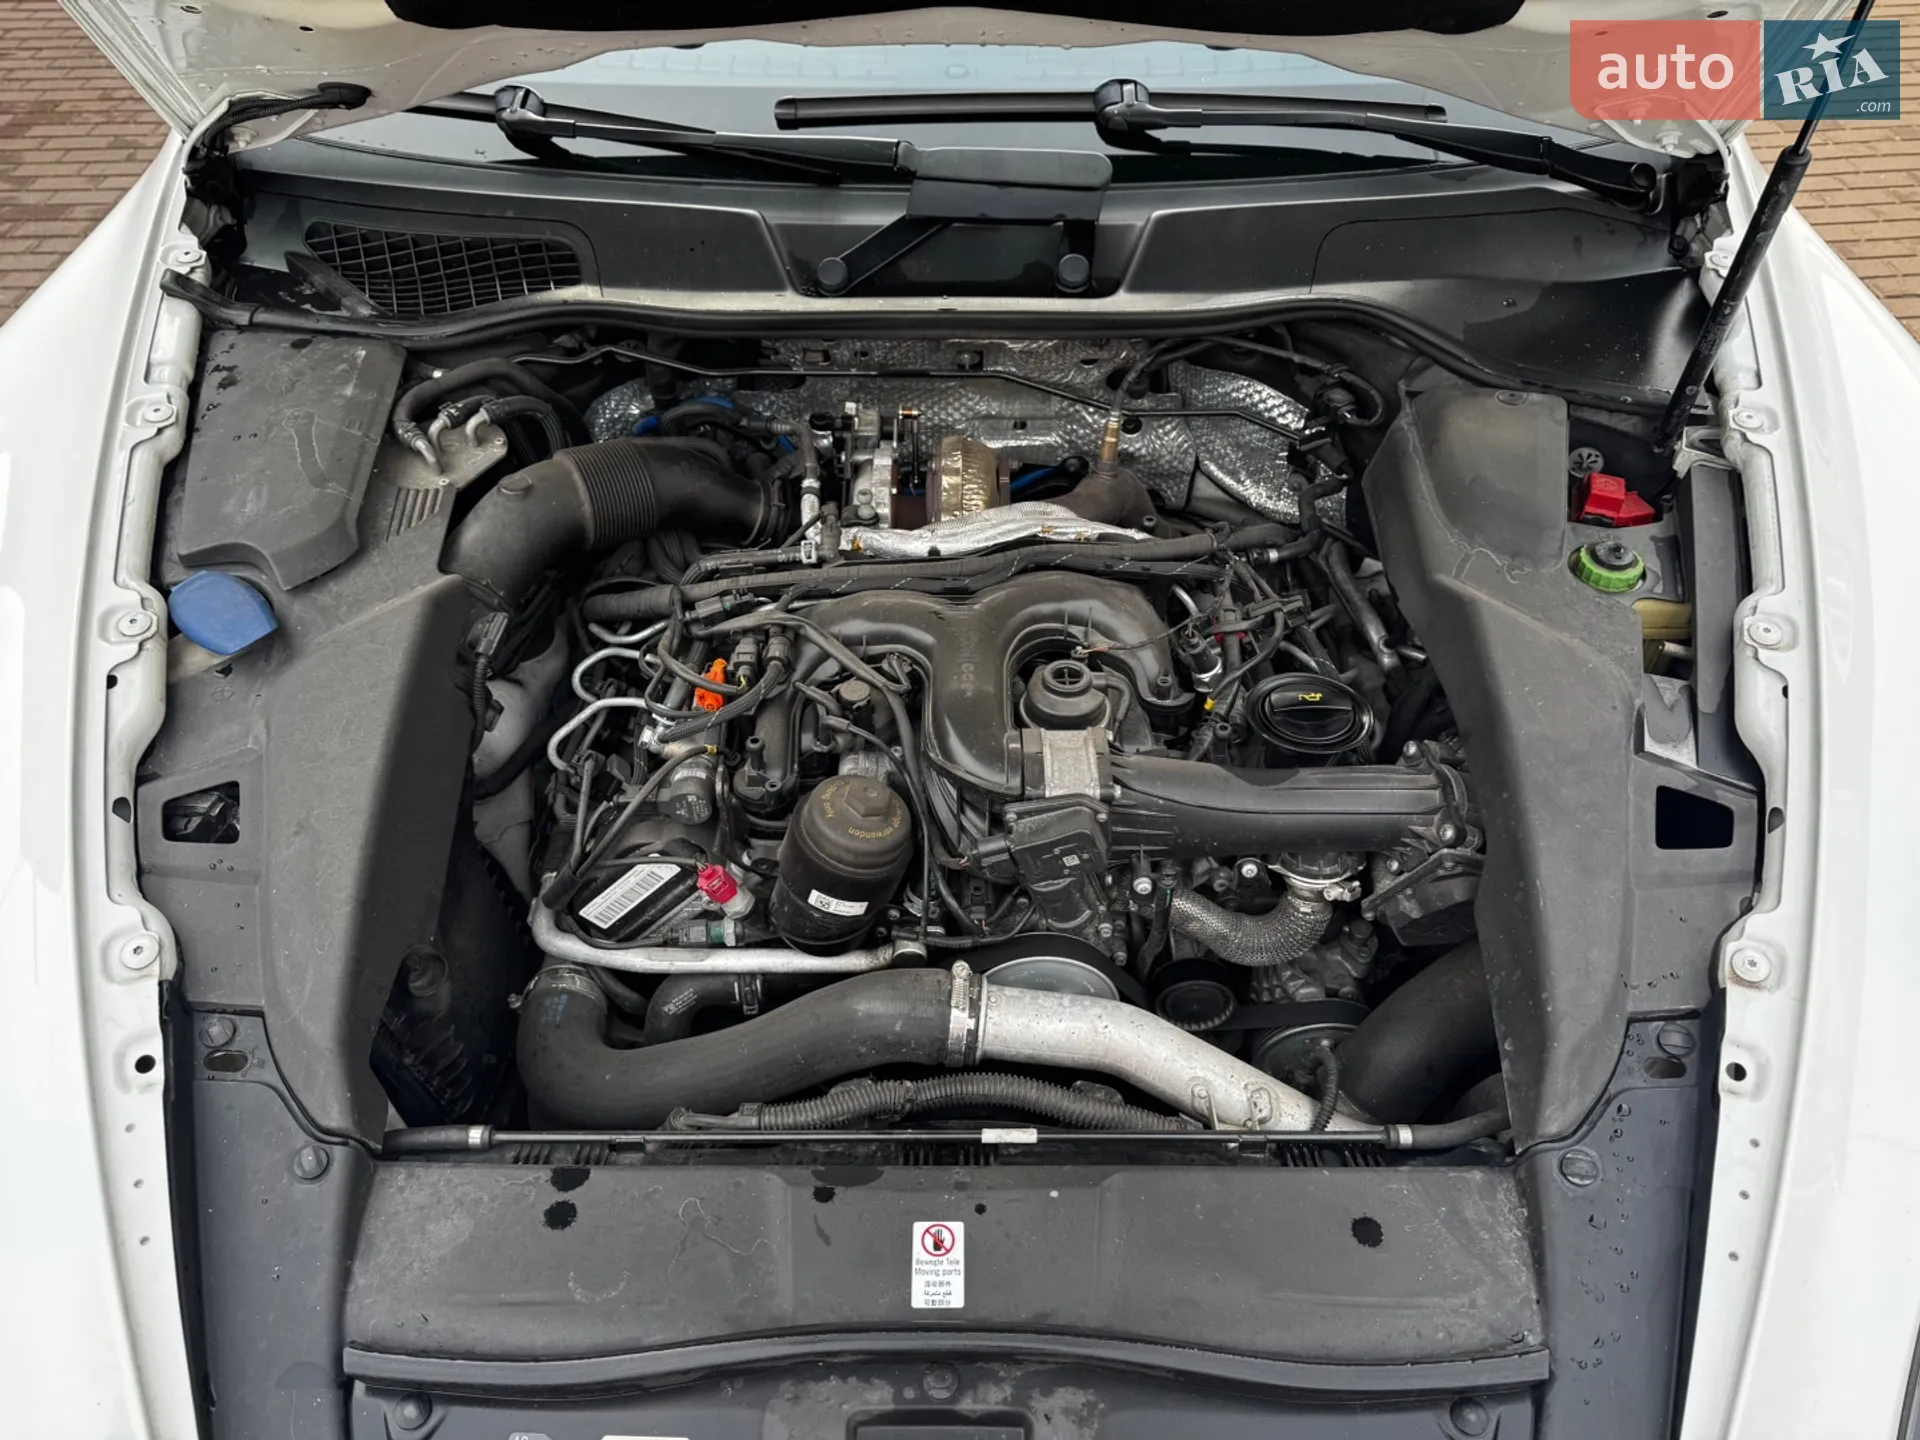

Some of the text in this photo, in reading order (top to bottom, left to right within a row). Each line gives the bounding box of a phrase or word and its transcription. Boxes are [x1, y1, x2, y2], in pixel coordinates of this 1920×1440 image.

[847, 826, 894, 839] verwenden
[915, 1267, 961, 1278] Moving parts
